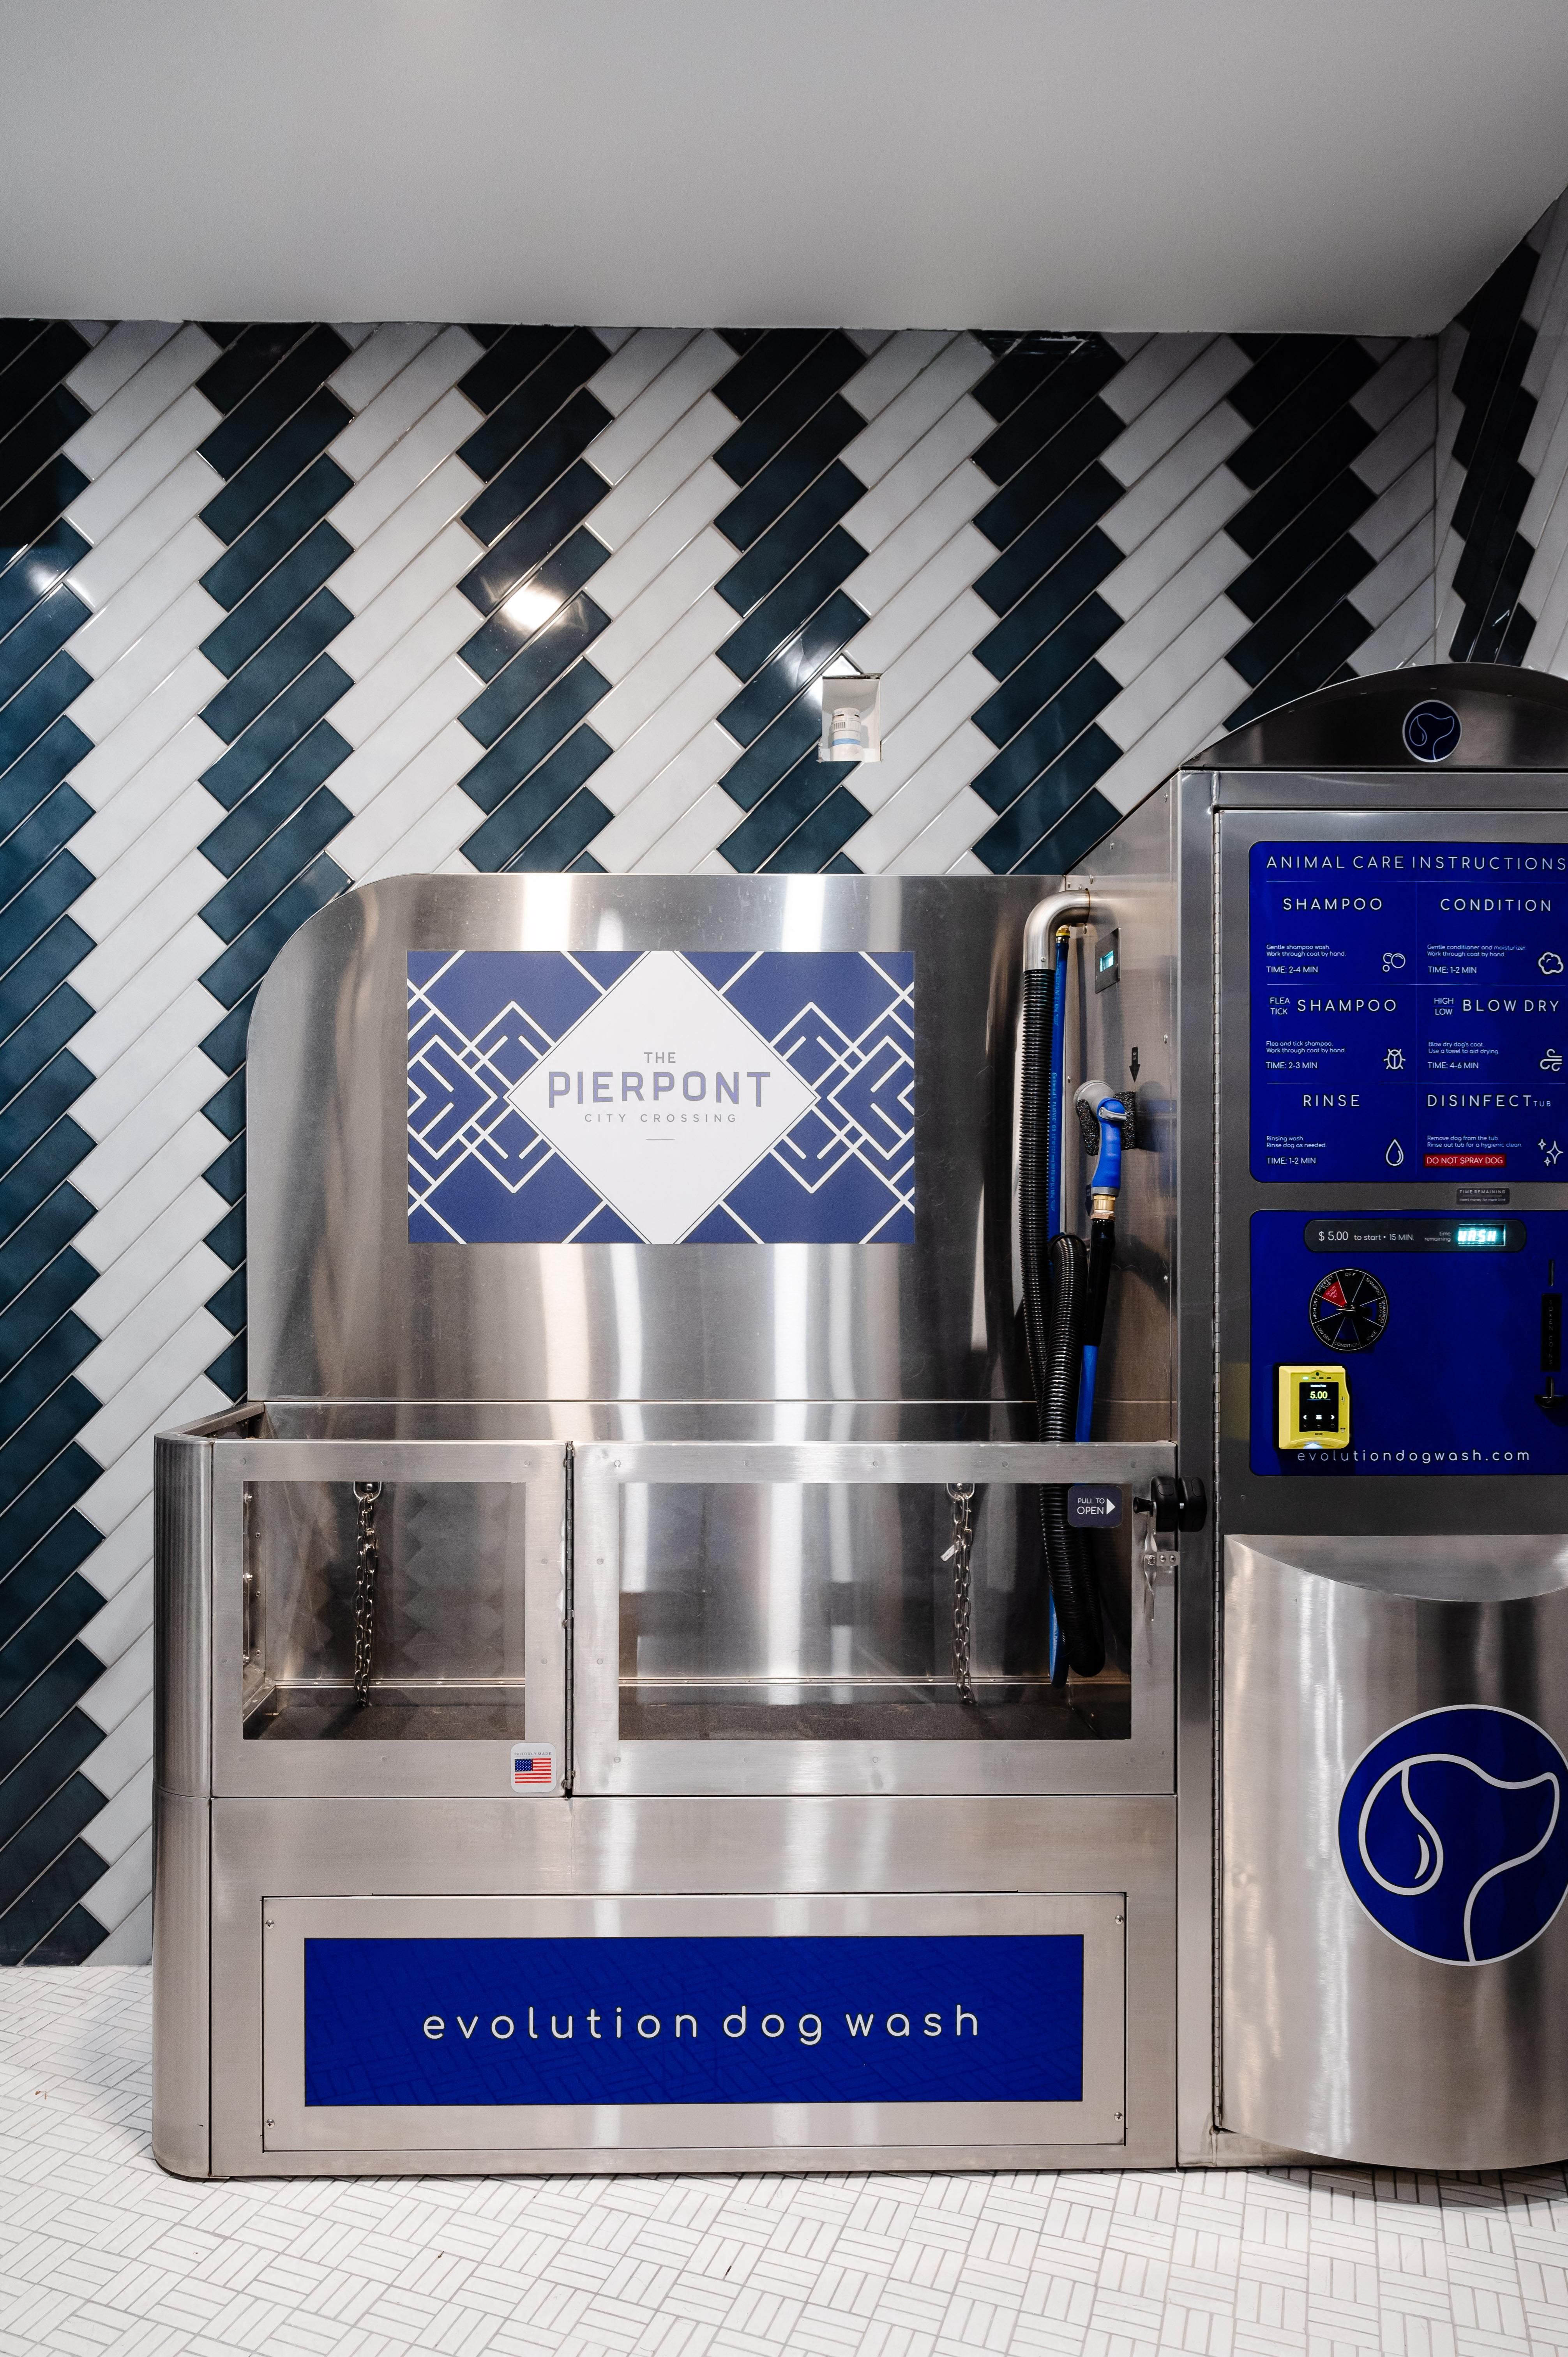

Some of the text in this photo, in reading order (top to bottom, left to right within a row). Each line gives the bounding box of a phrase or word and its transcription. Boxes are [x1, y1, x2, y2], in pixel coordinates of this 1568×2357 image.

[1266, 856, 1566, 870] ANIMAL CARE INSTRUCTIONS
[1283, 898, 1382, 910] SHAMPOO
[1440, 898, 1550, 911] CONDITION
[1298, 999, 1396, 1011] SHAMPOO
[1463, 999, 1517, 1011] BLOW
[1524, 1000, 1559, 1012] DRY
[643, 1052, 676, 1064] THE
[549, 1071, 771, 1109] PIERPONT
[1303, 1095, 1360, 1106] RINSE
[1428, 1095, 1532, 1107] DISINFECT
[584, 1114, 735, 1122] CITY CROSSING
[1318, 1231, 1325, 1242] $
[1328, 1231, 1349, 1241] 5.00
[1458, 1230, 1496, 1242] WASH
[1316, 1275, 1333, 1292] DISINFECT
[1323, 1281, 1331, 1290] TUB
[1365, 1278, 1381, 1296] SHAMPOO
[1323, 1333, 1331, 1341] DRY
[1310, 1391, 1328, 1399] 5.00
[1298, 1449, 1529, 1464] evolutiondogwash.com
[1077, 1506, 1104, 1515] OPEN
[424, 2004, 977, 2045] evolution dog wash
